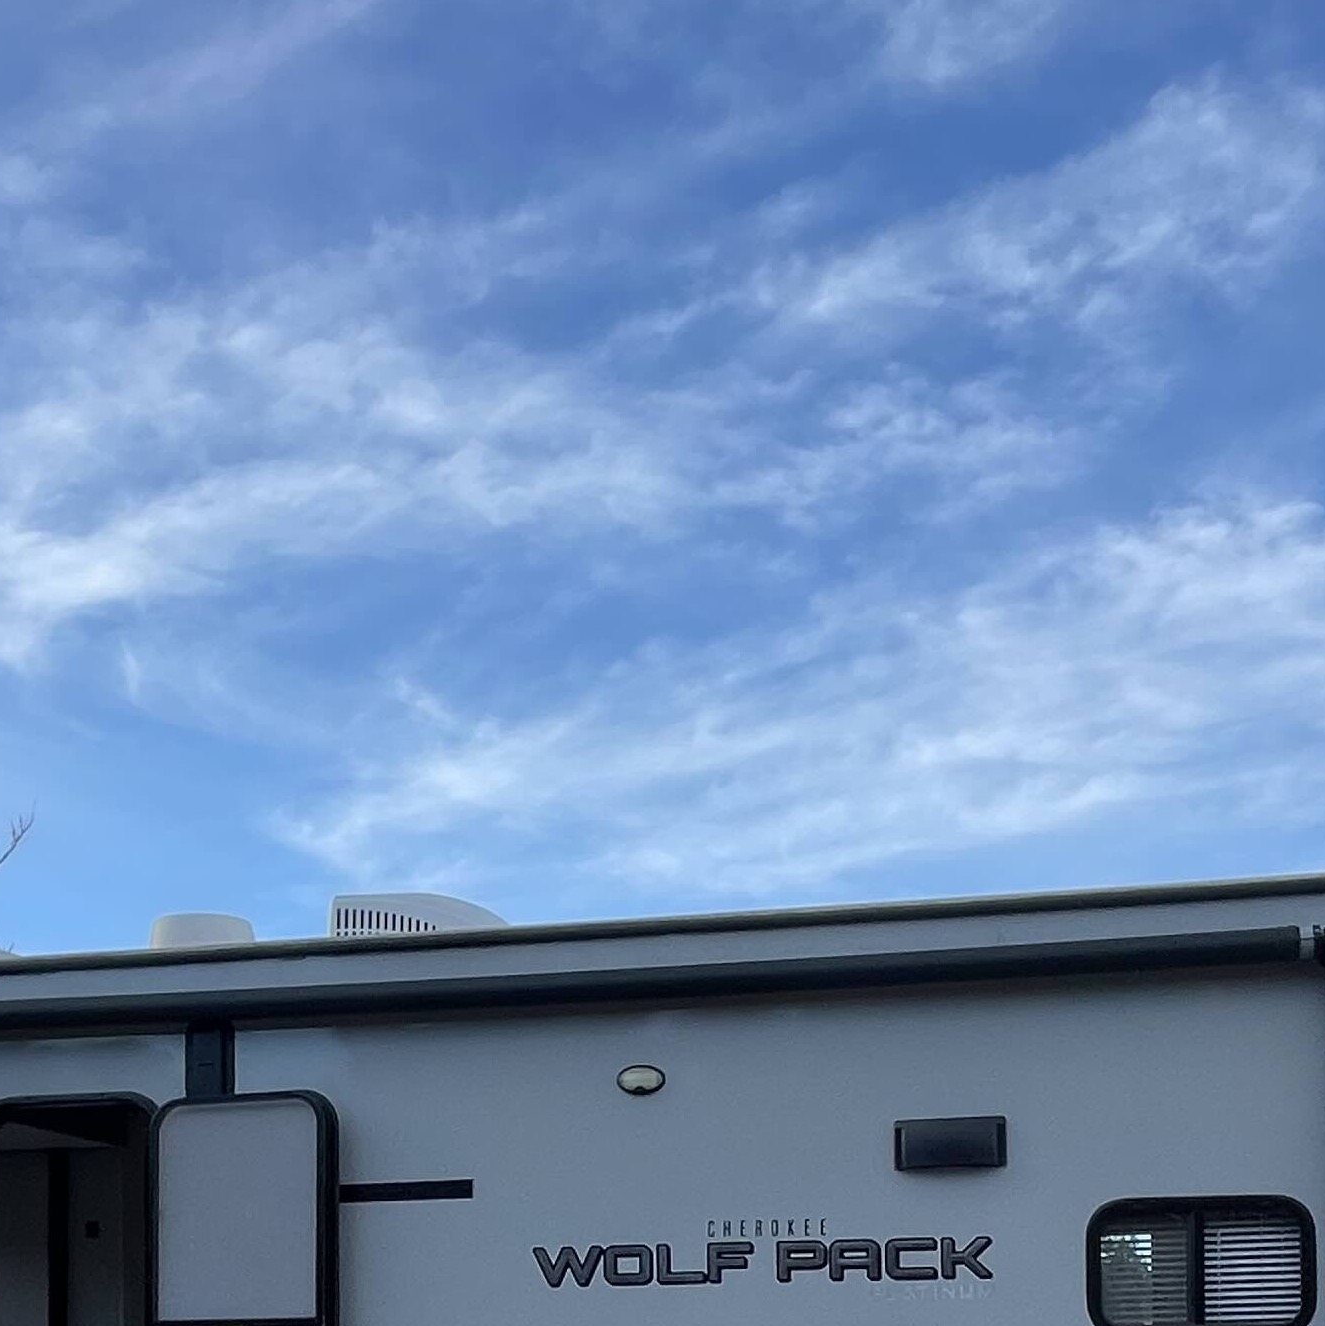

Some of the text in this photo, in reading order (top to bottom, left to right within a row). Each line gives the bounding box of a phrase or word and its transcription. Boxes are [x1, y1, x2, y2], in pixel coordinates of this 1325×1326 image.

[707, 1218, 827, 1238] CHEROKEE
[532, 1235, 994, 1288] WOLF PACK
